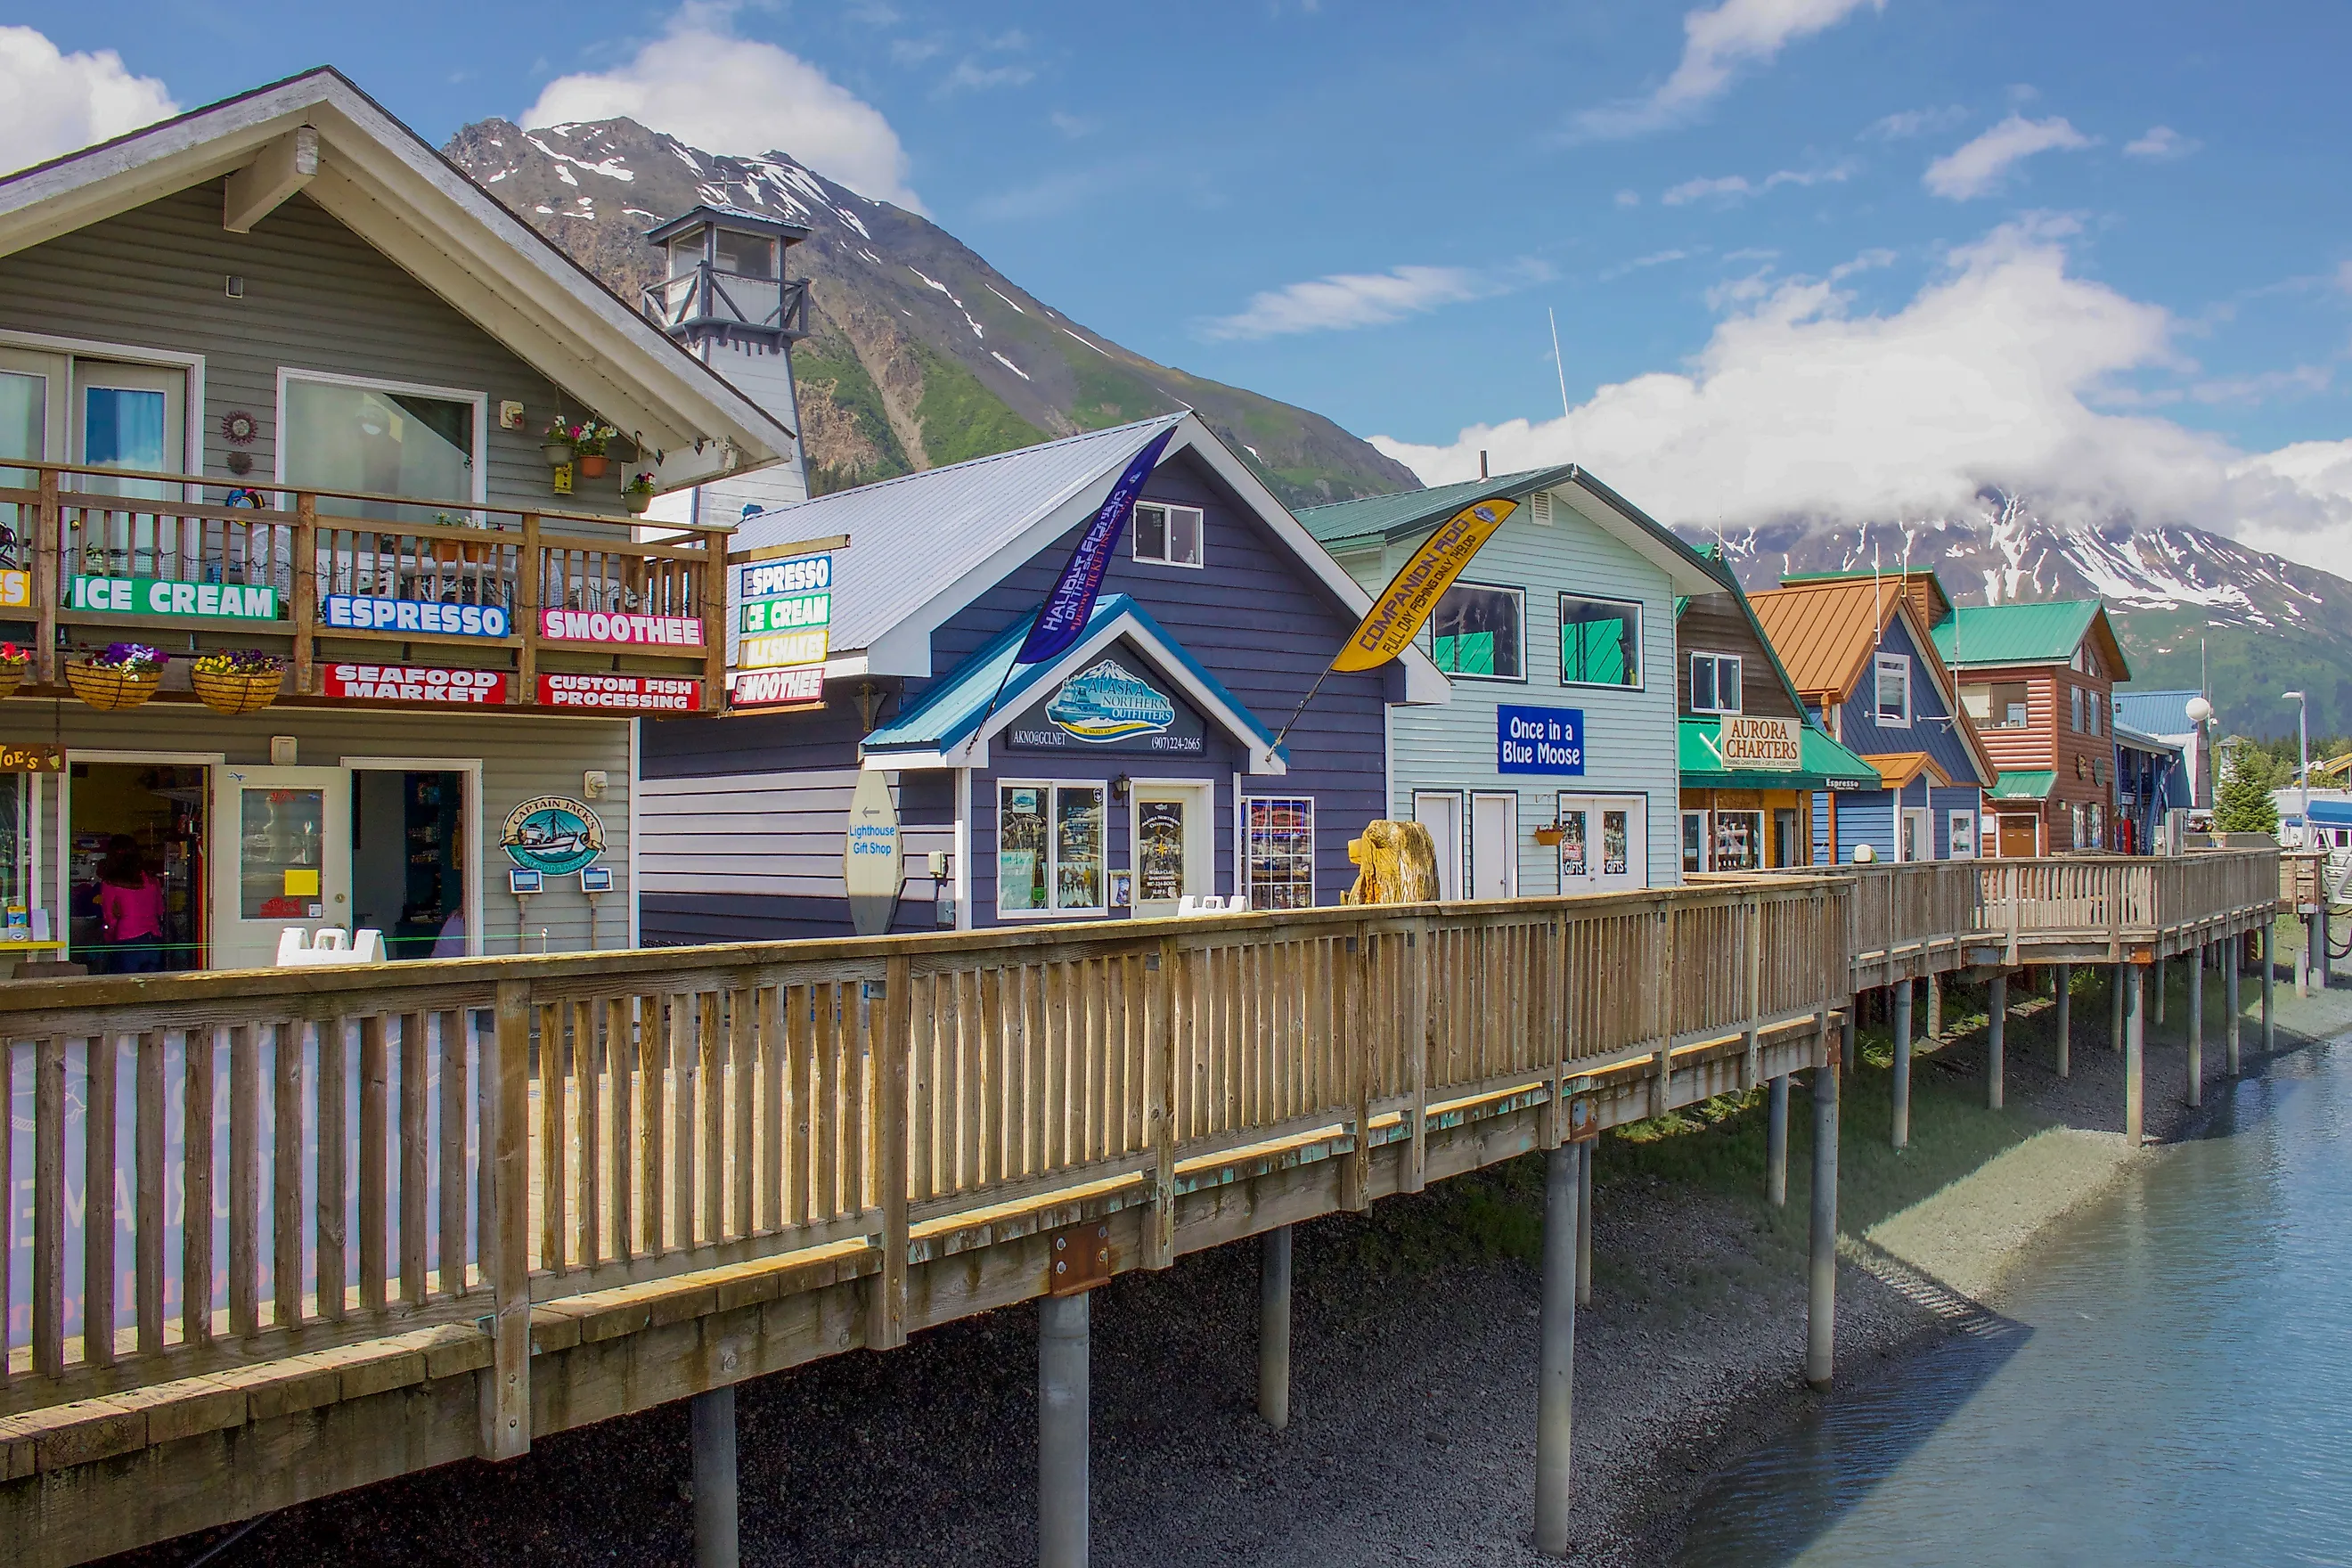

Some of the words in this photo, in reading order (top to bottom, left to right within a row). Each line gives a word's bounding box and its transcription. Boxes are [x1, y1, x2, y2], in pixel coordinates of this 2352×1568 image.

[744, 559, 829, 596] ESPRESSO
[1086, 552, 1105, 588] TICKET
[0, 571, 24, 604] S
[74, 577, 133, 610] ICE
[149, 582, 273, 617] CREAM
[1042, 556, 1085, 631] HALIBUT
[1071, 574, 1086, 598] THE
[1359, 552, 1439, 652] COMPANION
[1433, 518, 1471, 555] ROD
[1382, 631, 1406, 656] FULL
[1401, 610, 1417, 633] DAY
[1410, 578, 1437, 614] FISHING
[1435, 559, 1454, 584] ONLY
[1450, 535, 1476, 560] 149.00
[330, 597, 505, 635] ESPRESSO
[741, 604, 765, 632] ICE
[771, 595, 829, 628] CREAM
[1065, 601, 1078, 620] ON
[546, 611, 700, 645] SMOOTHEE
[739, 633, 825, 666] MILKSHAKES
[335, 665, 498, 687] SEAFOOD
[548, 675, 636, 692] CUSTOM
[645, 680, 691, 694] FISH
[734, 670, 821, 702] SMOOTHEE
[345, 682, 488, 702] MARKET
[552, 691, 688, 709] PROCESSING
[1088, 680, 1146, 697] ALASKA
[1102, 695, 1170, 710] NORTHERN
[1112, 708, 1171, 721] OUTFITTERS
[1510, 716, 1544, 739] Once
[1548, 718, 1561, 740] in
[1565, 723, 1573, 740] a
[1731, 719, 1789, 739] AURORA
[1503, 740, 1533, 764] Blue
[1538, 742, 1580, 765] Moose
[1726, 739, 1798, 759] CHARTERS
[1826, 779, 1859, 788] Espresso
[513, 800, 560, 825] CAPTAIN
[564, 801, 597, 829] JACK'S
[849, 825, 895, 839] Lighthouse
[853, 842, 868, 854] Gift
[870, 842, 892, 857] Shop
[1565, 861, 1583, 875] GIFTS
[1606, 861, 1624, 873] GIFTS
